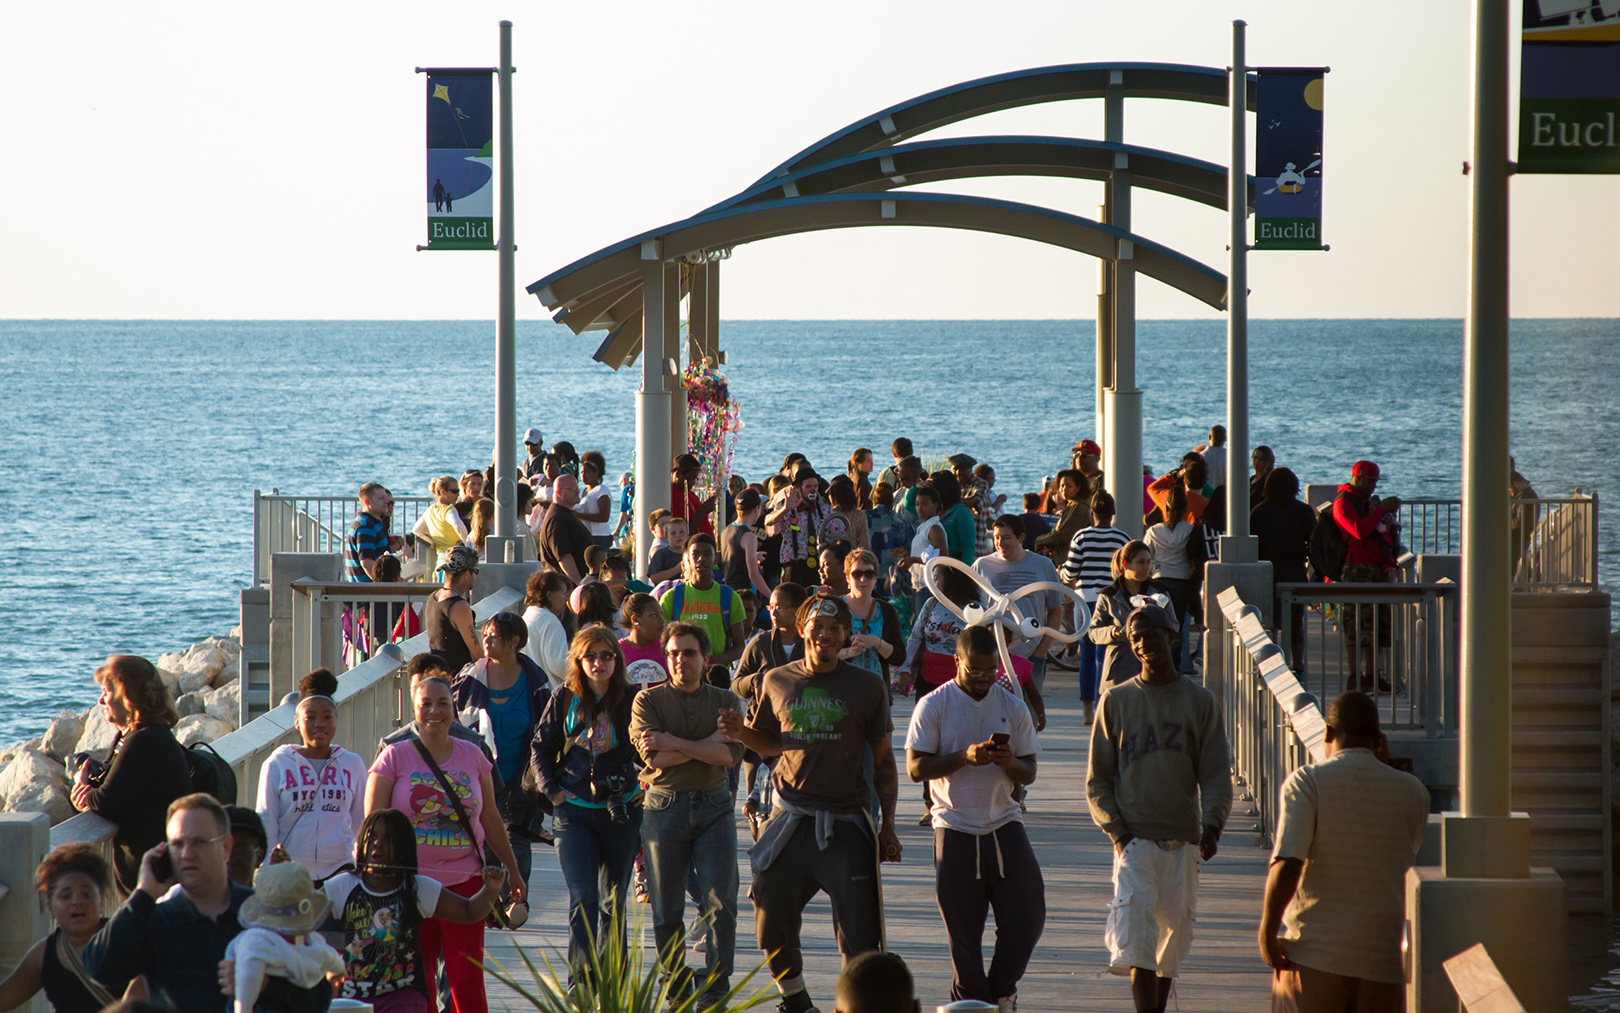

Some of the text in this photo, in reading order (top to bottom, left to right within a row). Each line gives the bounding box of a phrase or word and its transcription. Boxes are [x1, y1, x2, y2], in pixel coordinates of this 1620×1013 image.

[1531, 112, 1620, 146] Eucl
[432, 221, 488, 238] Euclid
[1260, 222, 1316, 239] Euclid
[681, 599, 722, 614] Hollister
[784, 696, 849, 716] GUINNESS
[413, 828, 472, 847] CHILL
